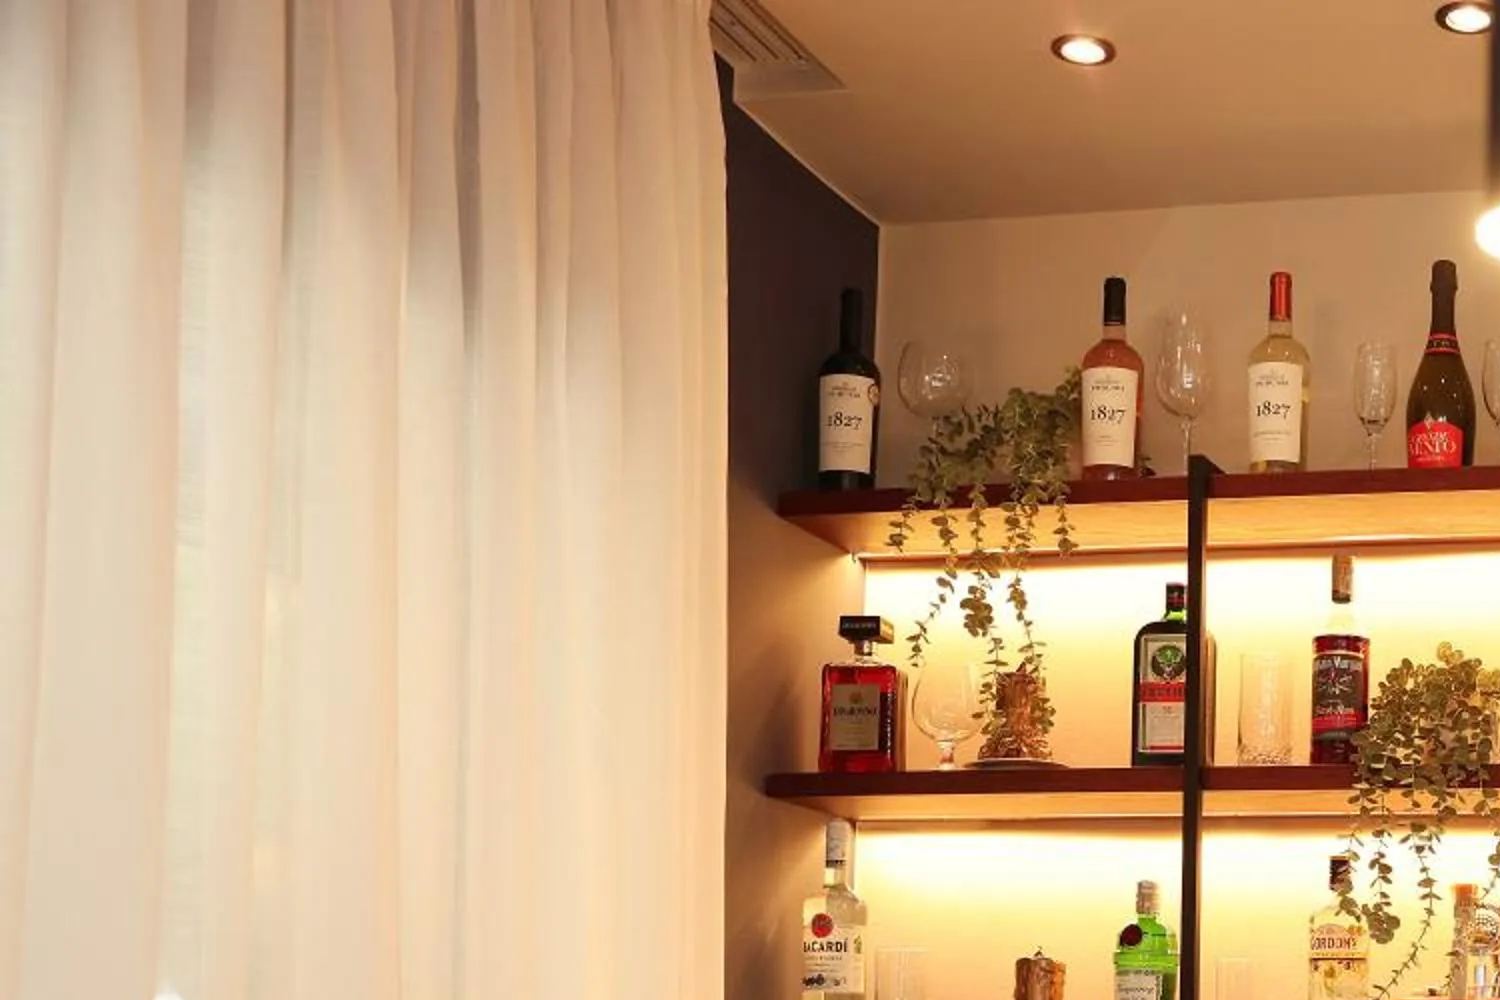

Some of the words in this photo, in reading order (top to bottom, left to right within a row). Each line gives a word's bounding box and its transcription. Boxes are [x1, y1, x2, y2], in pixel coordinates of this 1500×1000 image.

[1090, 404, 1127, 424] 1827
[1256, 400, 1291, 419] 1827
[826, 411, 863, 431] 1827
